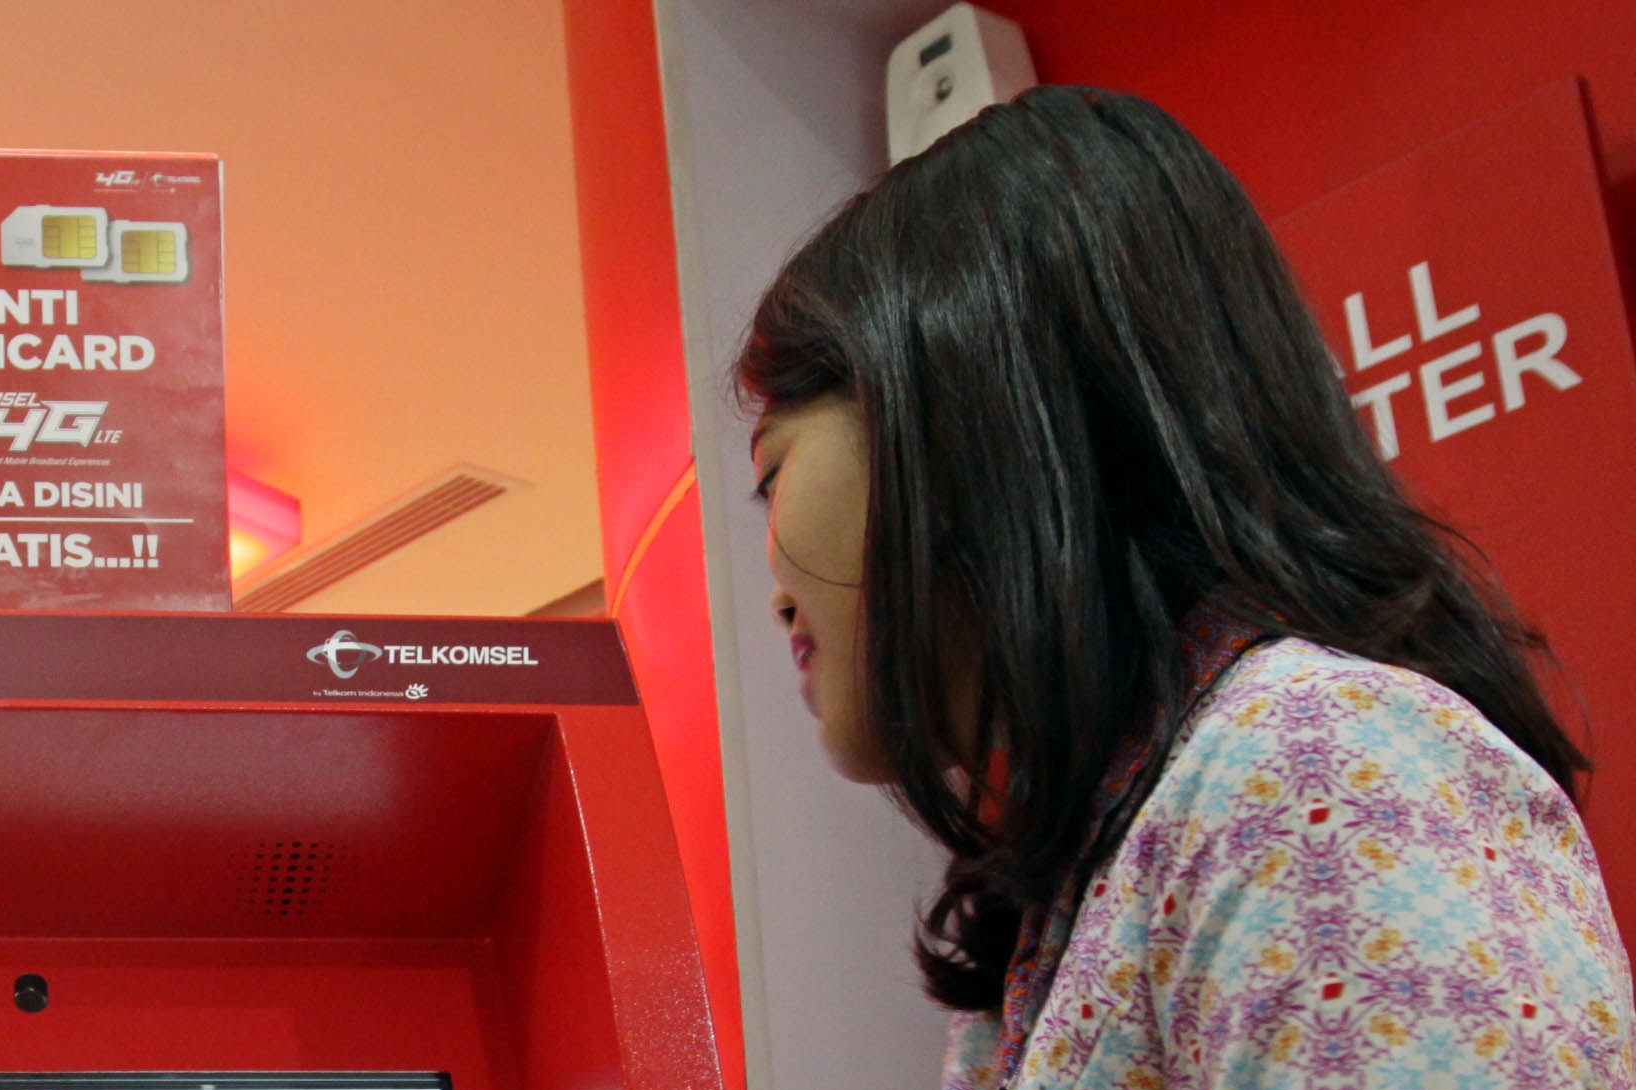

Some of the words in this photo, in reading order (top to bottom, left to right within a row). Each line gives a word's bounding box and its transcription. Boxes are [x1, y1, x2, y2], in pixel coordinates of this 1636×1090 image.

[1328, 261, 1481, 380] LL
[1349, 312, 1583, 463] TER
[94, 429, 123, 444] LTE
[34, 481, 143, 509] DISINI
[383, 645, 539, 666] TELKOMSEL
[323, 689, 356, 697] Telkom
